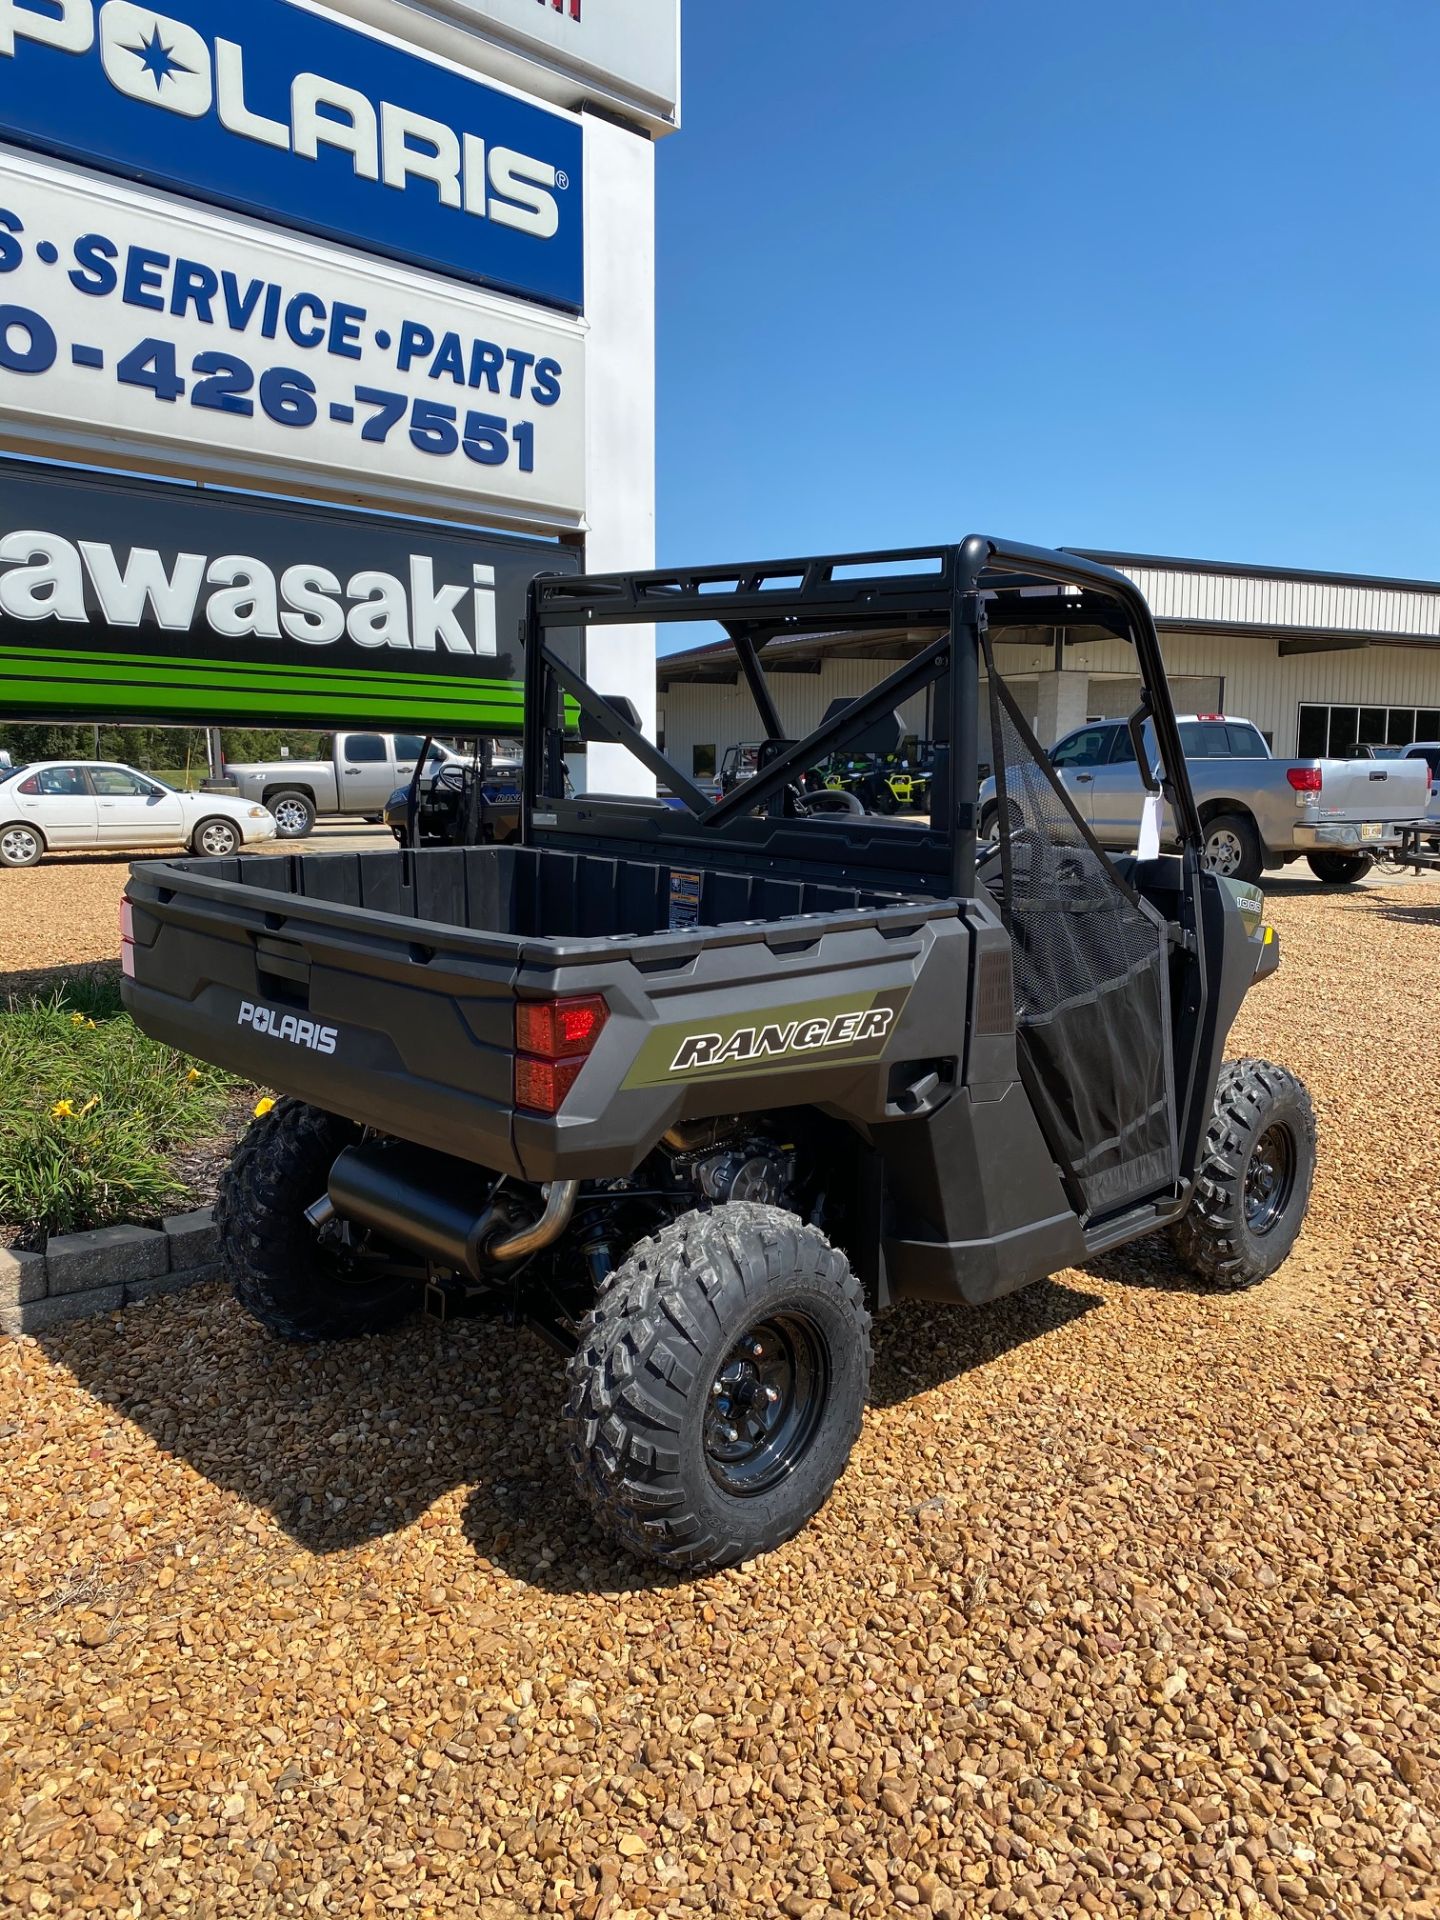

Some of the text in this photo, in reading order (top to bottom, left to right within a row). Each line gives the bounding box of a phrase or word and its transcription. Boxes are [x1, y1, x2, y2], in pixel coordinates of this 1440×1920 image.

[67, 233, 367, 359] SERVICE
[396, 320, 562, 406] PARTS
[0, 530, 497, 657] awasaki
[237, 1000, 338, 1055] POLARIS
[669, 1007, 894, 1071] RANGER
